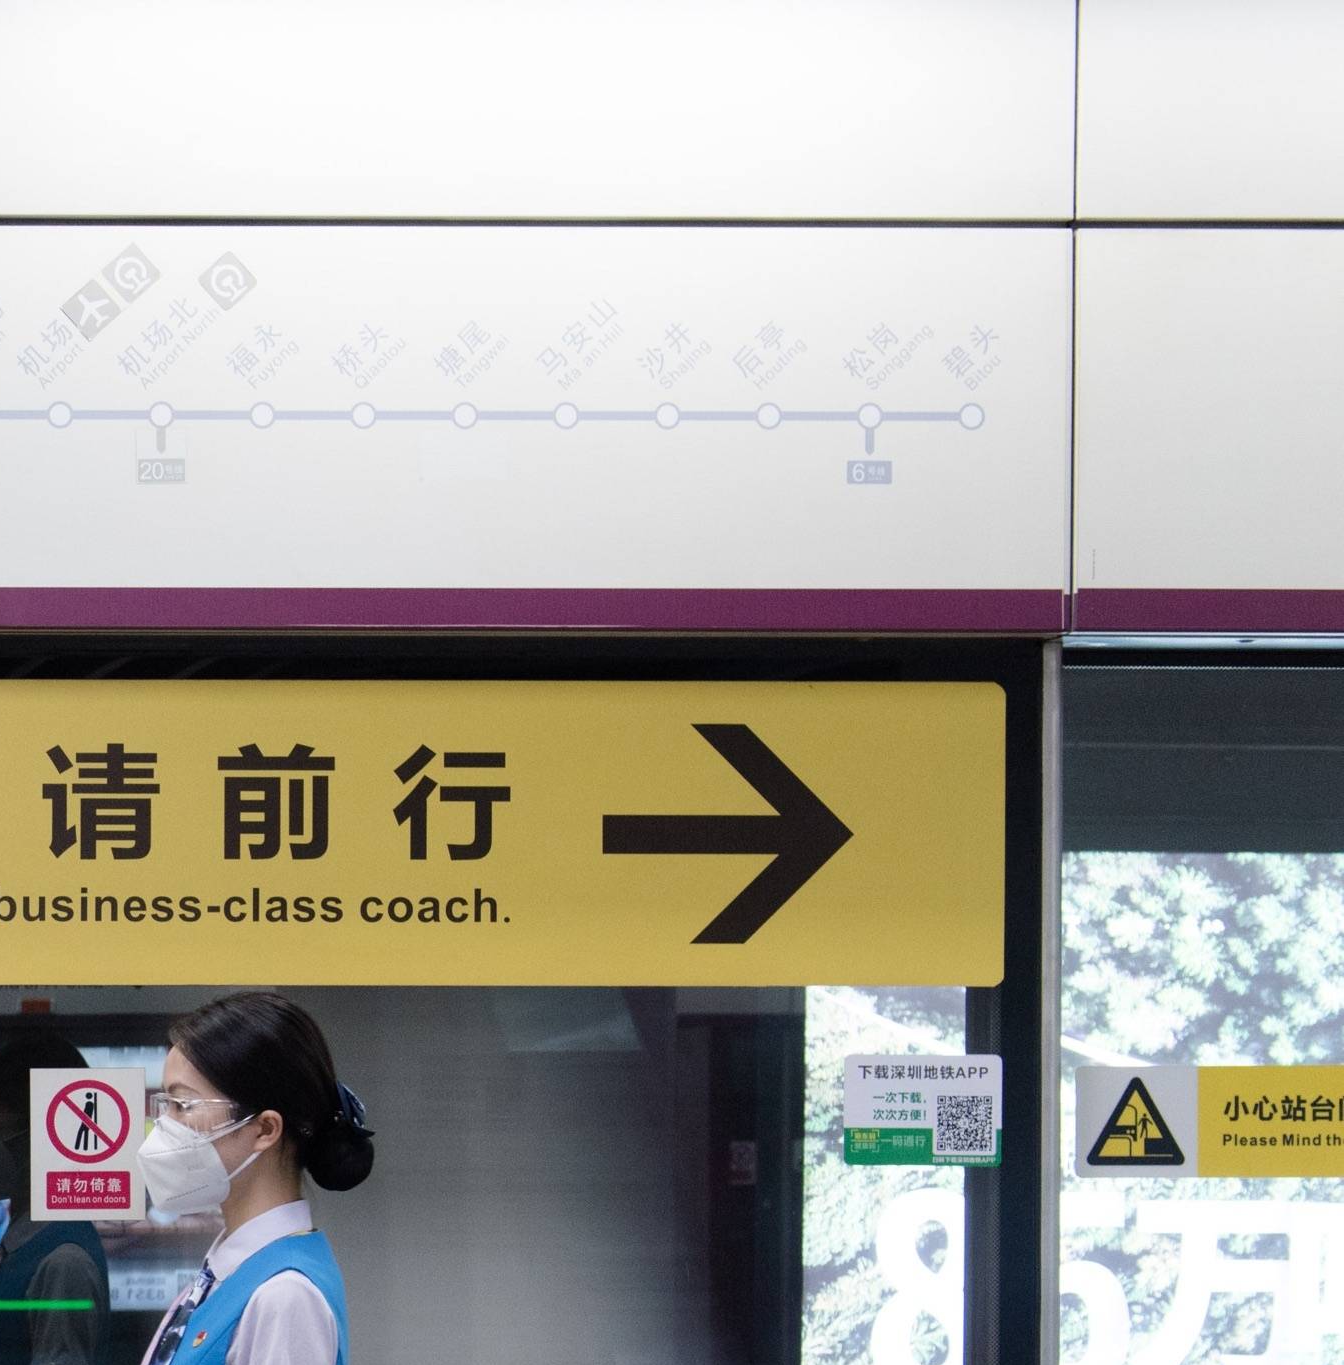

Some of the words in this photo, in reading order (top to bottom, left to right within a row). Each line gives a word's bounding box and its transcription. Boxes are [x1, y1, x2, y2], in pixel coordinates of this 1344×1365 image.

[17, 319, 77, 378] 机场
[116, 296, 199, 378] 机场北
[225, 320, 283, 379] 福永
[330, 320, 389, 378] 桥头
[432, 318, 492, 379] 塘尾
[453, 334, 511, 391] Tangwei
[535, 295, 619, 377] 马安山
[635, 319, 692, 379] 沙井
[730, 319, 788, 379] 后亭
[37, 343, 85, 391] Airport
[139, 341, 187, 391] Airport
[247, 338, 300, 391] Fuyong
[354, 337, 408, 391] Qiaotou
[659, 339, 713, 391] Shajing
[753, 336, 809, 391] Houting
[965, 354, 1004, 391] Bitou
[360, 887, 512, 924] coach.
[858, 1065, 989, 1080] 下载深圳地铁APP
[1223, 1095, 1344, 1122] 小心站台
[1223, 1133, 1277, 1147] Please
[1282, 1133, 1323, 1147] Mind
[51, 1195, 73, 1204] Don't
[74, 1195, 91, 1204] lean
[92, 1196, 103, 1204] on
[104, 1195, 126, 1204] doors
[57, 1177, 122, 1193] 请勿倚靠
